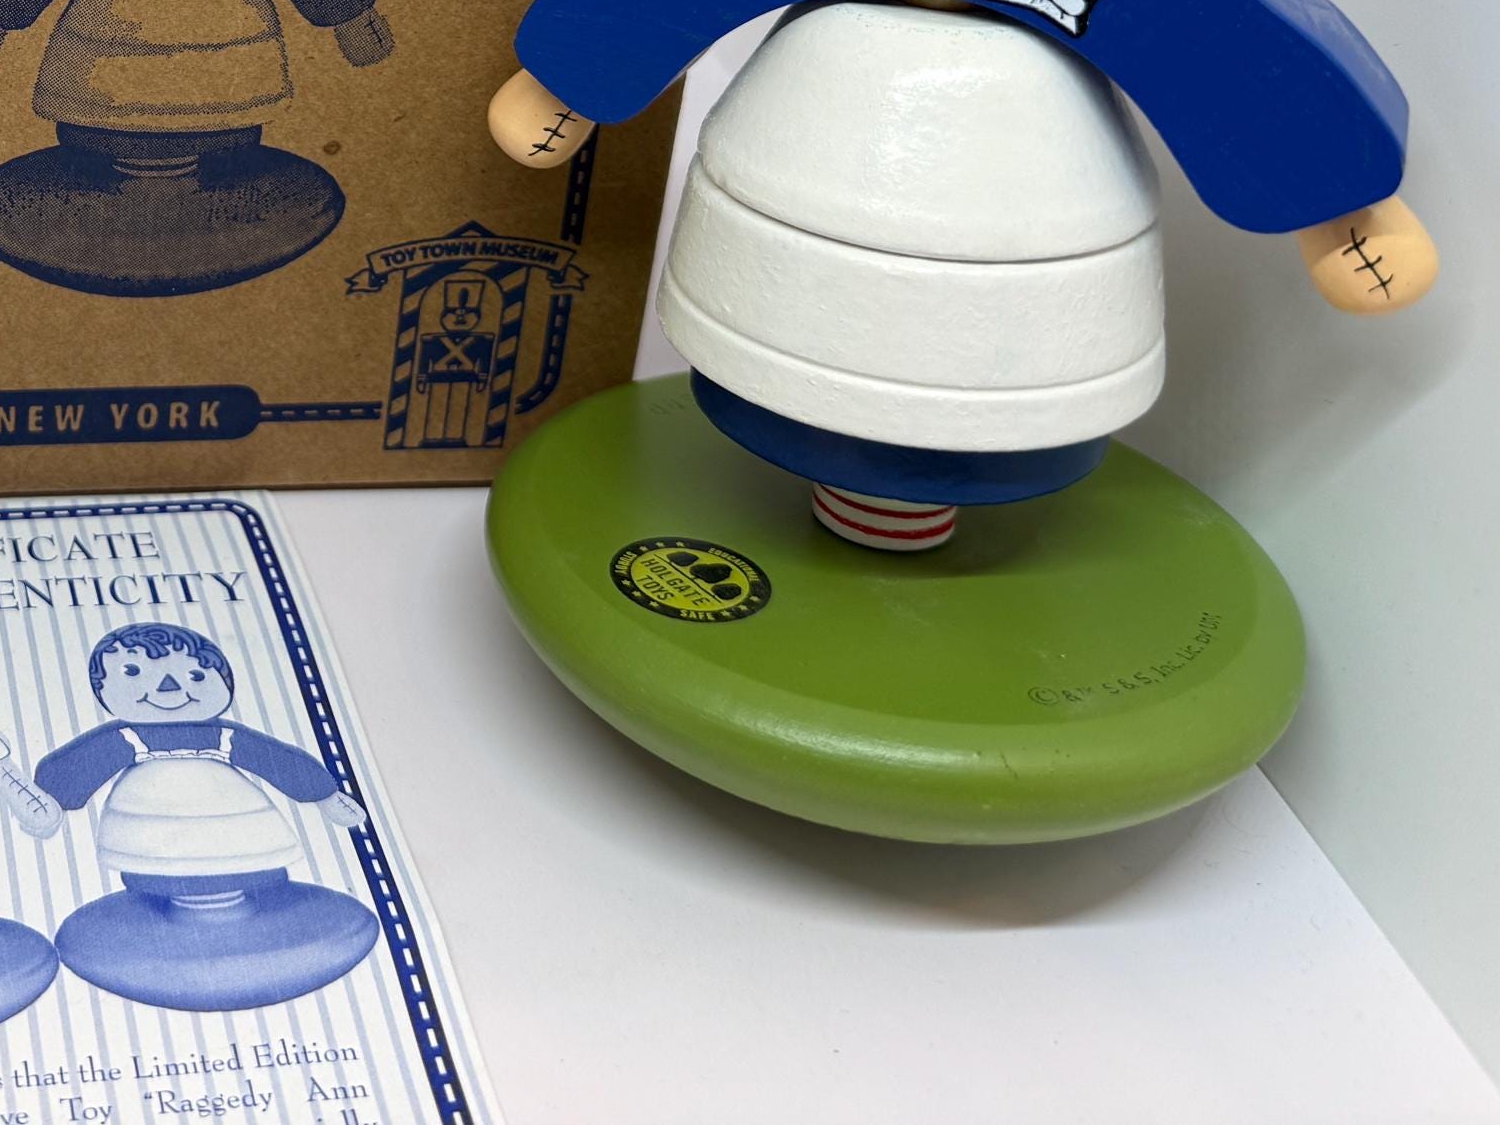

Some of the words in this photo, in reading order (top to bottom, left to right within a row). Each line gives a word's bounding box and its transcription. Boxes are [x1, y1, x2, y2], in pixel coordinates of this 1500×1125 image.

[381, 246, 417, 266] TOY
[419, 242, 477, 259] TOWN
[478, 242, 558, 264] MUSEUM
[111, 401, 220, 430] YORK
[636, 575, 675, 601] TOYS
[641, 558, 711, 606] HOLGATE
[680, 609, 716, 621] SAFE
[13, 1060, 70, 1088] that
[79, 1055, 123, 1082] the
[132, 1043, 244, 1080] Limited
[252, 1038, 360, 1069] Edition
[59, 1096, 113, 1125] Toy
[306, 1077, 370, 1103] Ann
